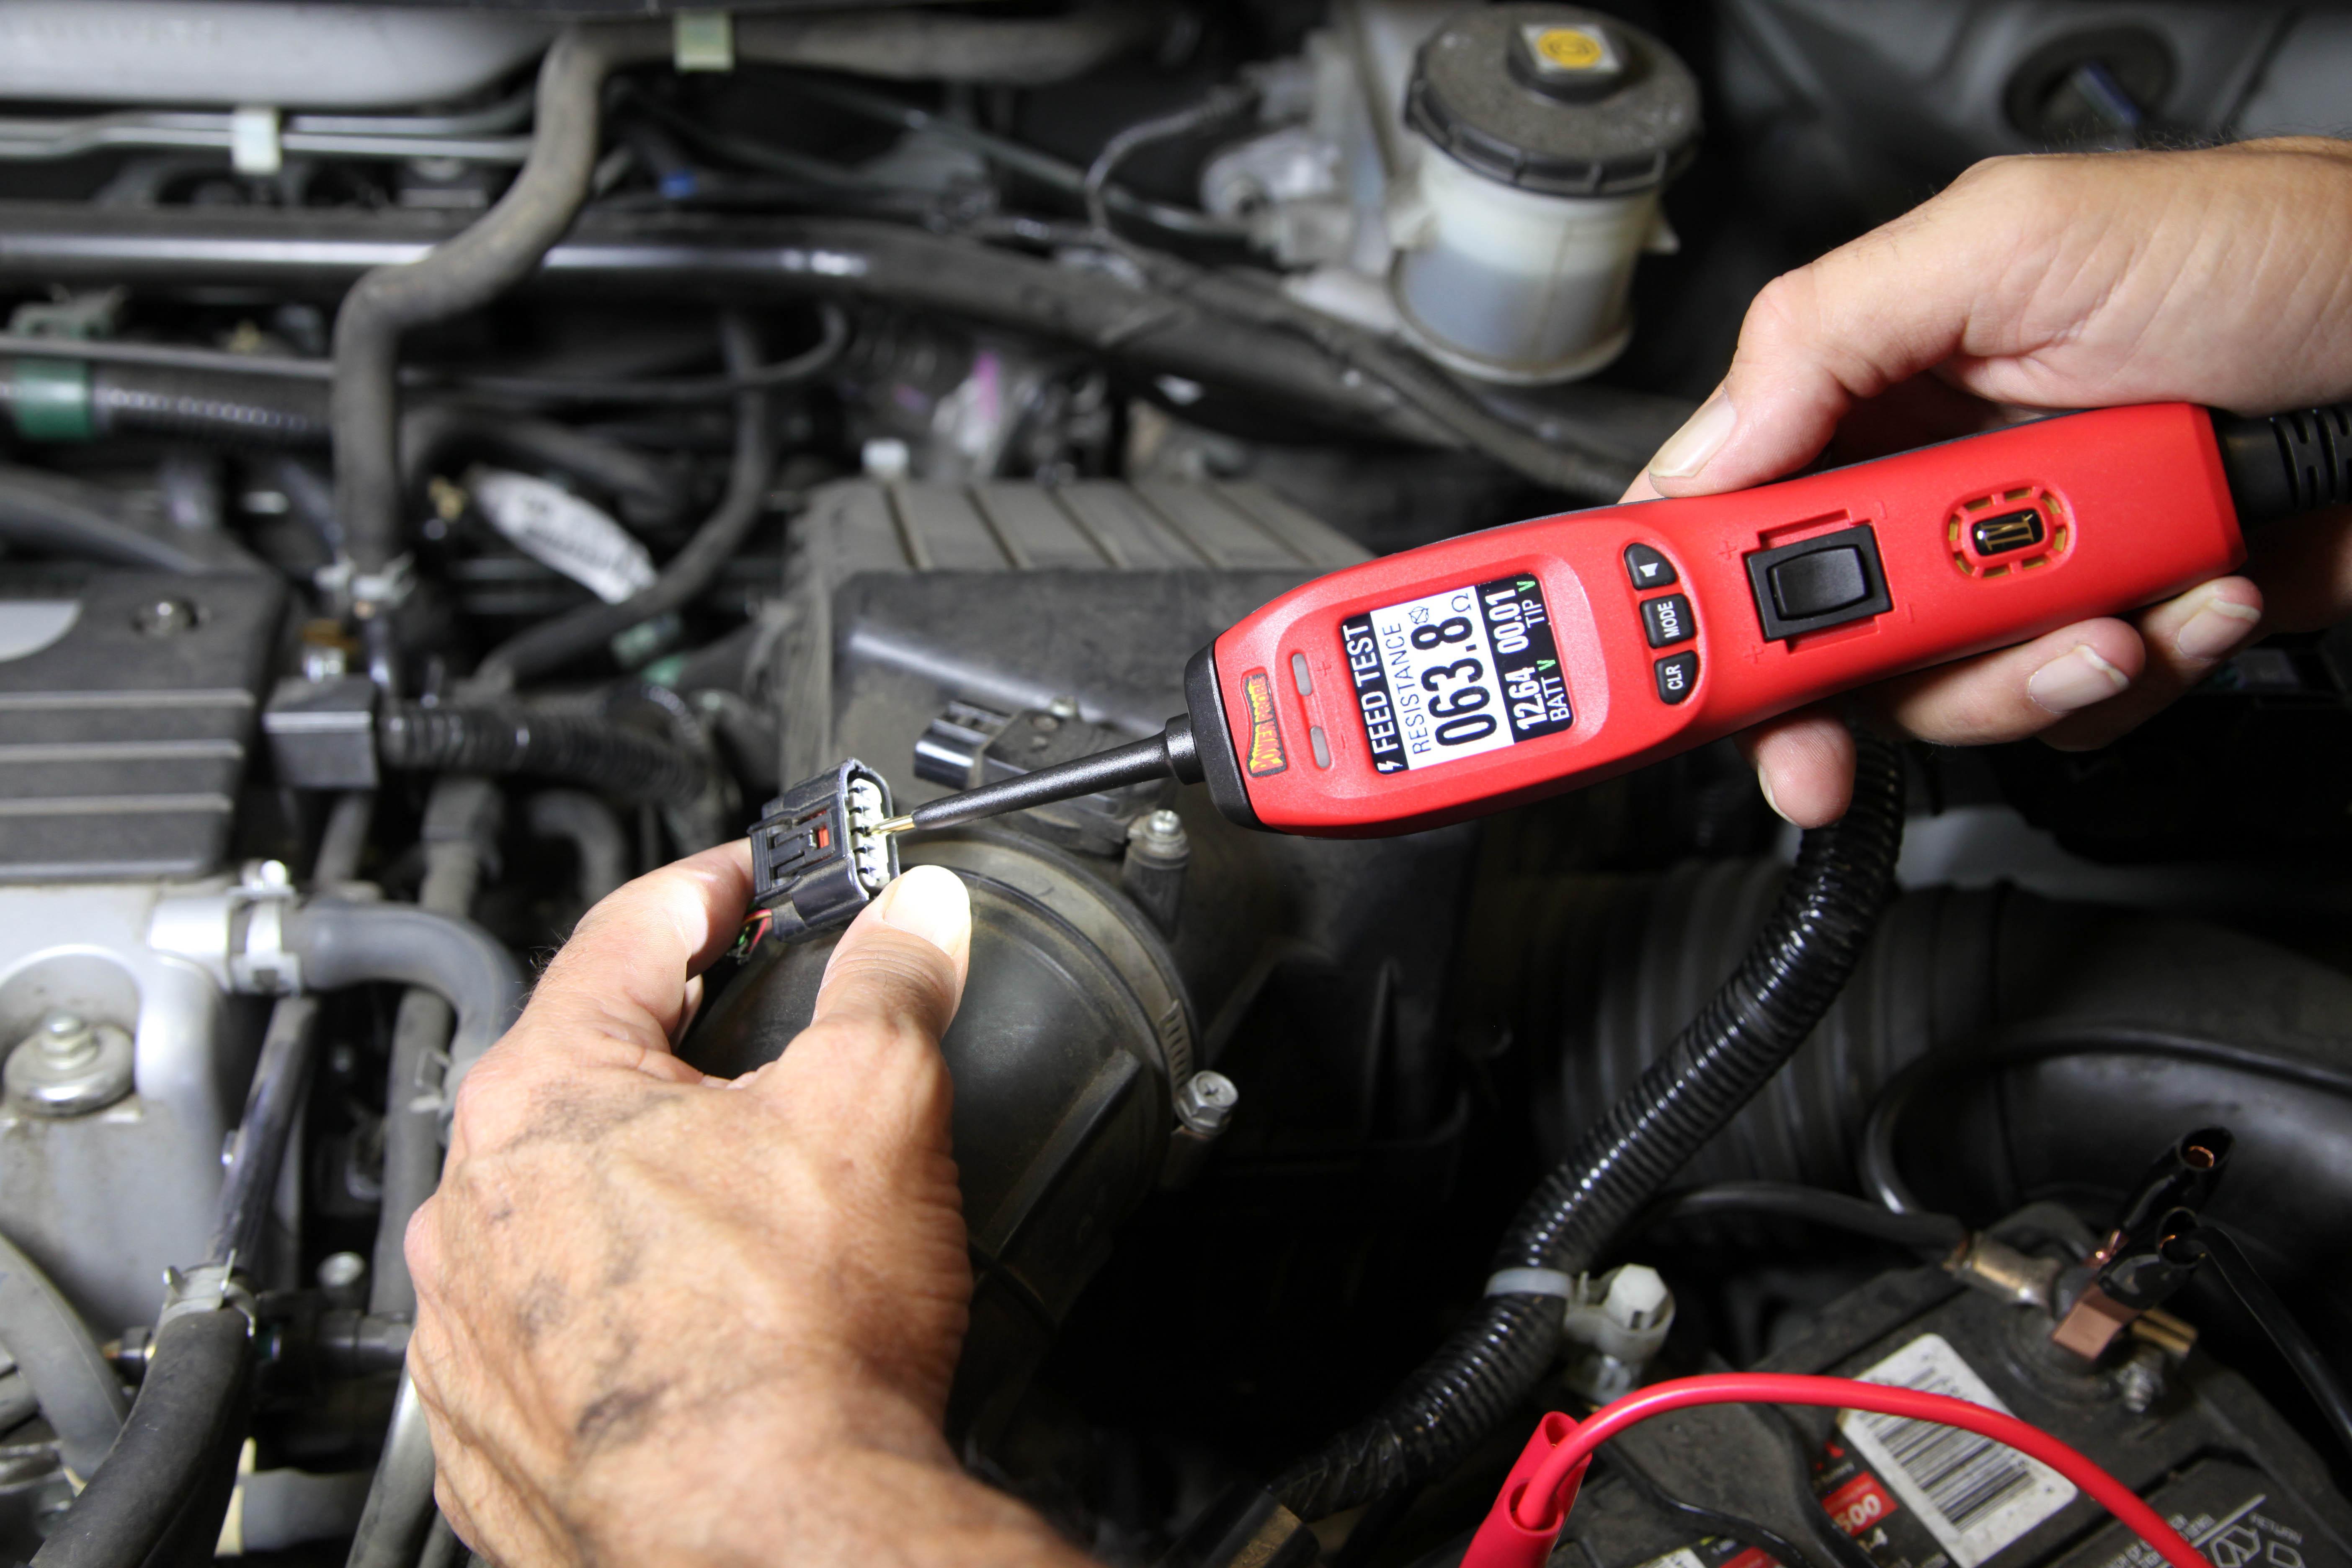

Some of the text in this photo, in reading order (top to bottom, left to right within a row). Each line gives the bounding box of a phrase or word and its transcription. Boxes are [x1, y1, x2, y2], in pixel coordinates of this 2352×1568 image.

[1485, 589, 1529, 654] 00.01
[1522, 600, 1545, 628] TIP
[1657, 601, 1680, 639] MODE
[1343, 625, 1398, 753] FEED TEST
[1382, 623, 1431, 754] RESISTANCE
[1411, 617, 1497, 745] 063.8
[1505, 667, 1547, 730] 12.64
[1541, 677, 1570, 721] BATT
[1665, 664, 1683, 690] CLR
[1248, 676, 1284, 774] POWER PROBE
